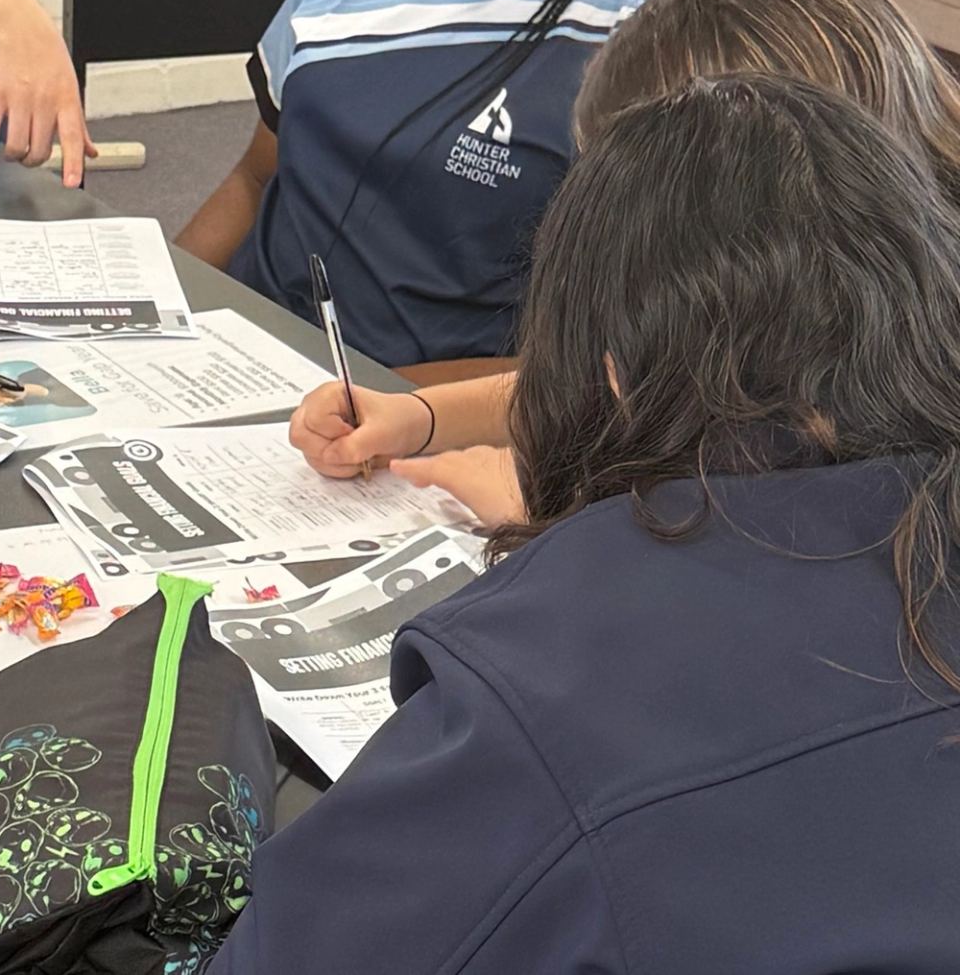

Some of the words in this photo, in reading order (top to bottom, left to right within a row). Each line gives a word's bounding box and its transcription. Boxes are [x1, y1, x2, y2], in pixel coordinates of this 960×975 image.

[456, 133, 510, 162] HUNTER
[444, 158, 498, 188] SCHOOL
[450, 146, 521, 179] CHRISTIAN
[69, 369, 110, 394] Bella
[93, 362, 121, 380] Gap
[278, 651, 344, 674] SETTING
